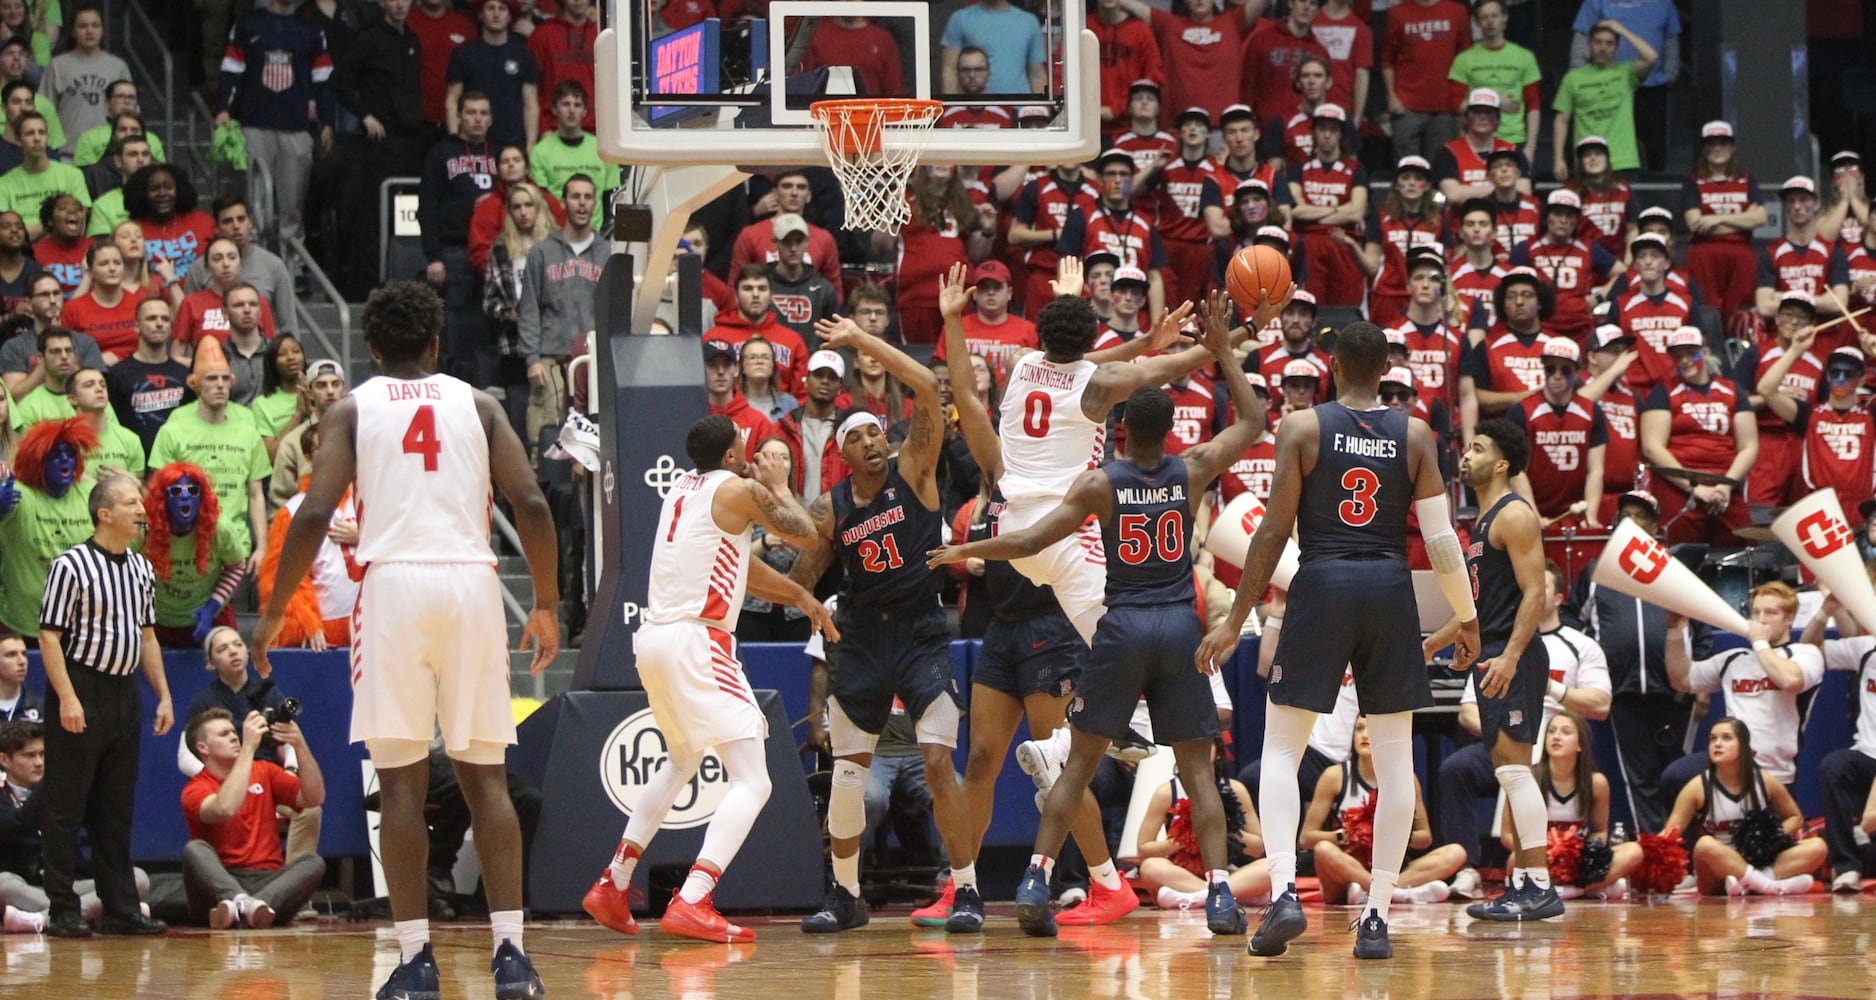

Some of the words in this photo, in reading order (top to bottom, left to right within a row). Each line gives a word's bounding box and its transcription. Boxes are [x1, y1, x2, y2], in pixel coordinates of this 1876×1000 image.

[1404, 20, 1451, 34] FLYERS
[657, 31, 702, 78] DAYTON
[65, 74, 106, 97] DAYTO
[387, 383, 442, 401] DAVIS
[1019, 363, 1076, 391] CUNNINGHAM
[1023, 390, 1052, 438] 0
[1816, 421, 1866, 435] DAYTON
[402, 404, 442, 472] 4
[1345, 435, 1397, 459] HUGHES
[1535, 430, 1586, 444] DAYTON
[1116, 487, 1169, 505] WILLIAMS
[1169, 484, 1187, 502] JR.
[1338, 467, 1383, 527] 3
[667, 494, 686, 544] 1
[841, 505, 906, 546] DUQUESNE
[1117, 509, 1185, 565] 50
[858, 533, 904, 573] 21
[619, 727, 729, 811] Krger
